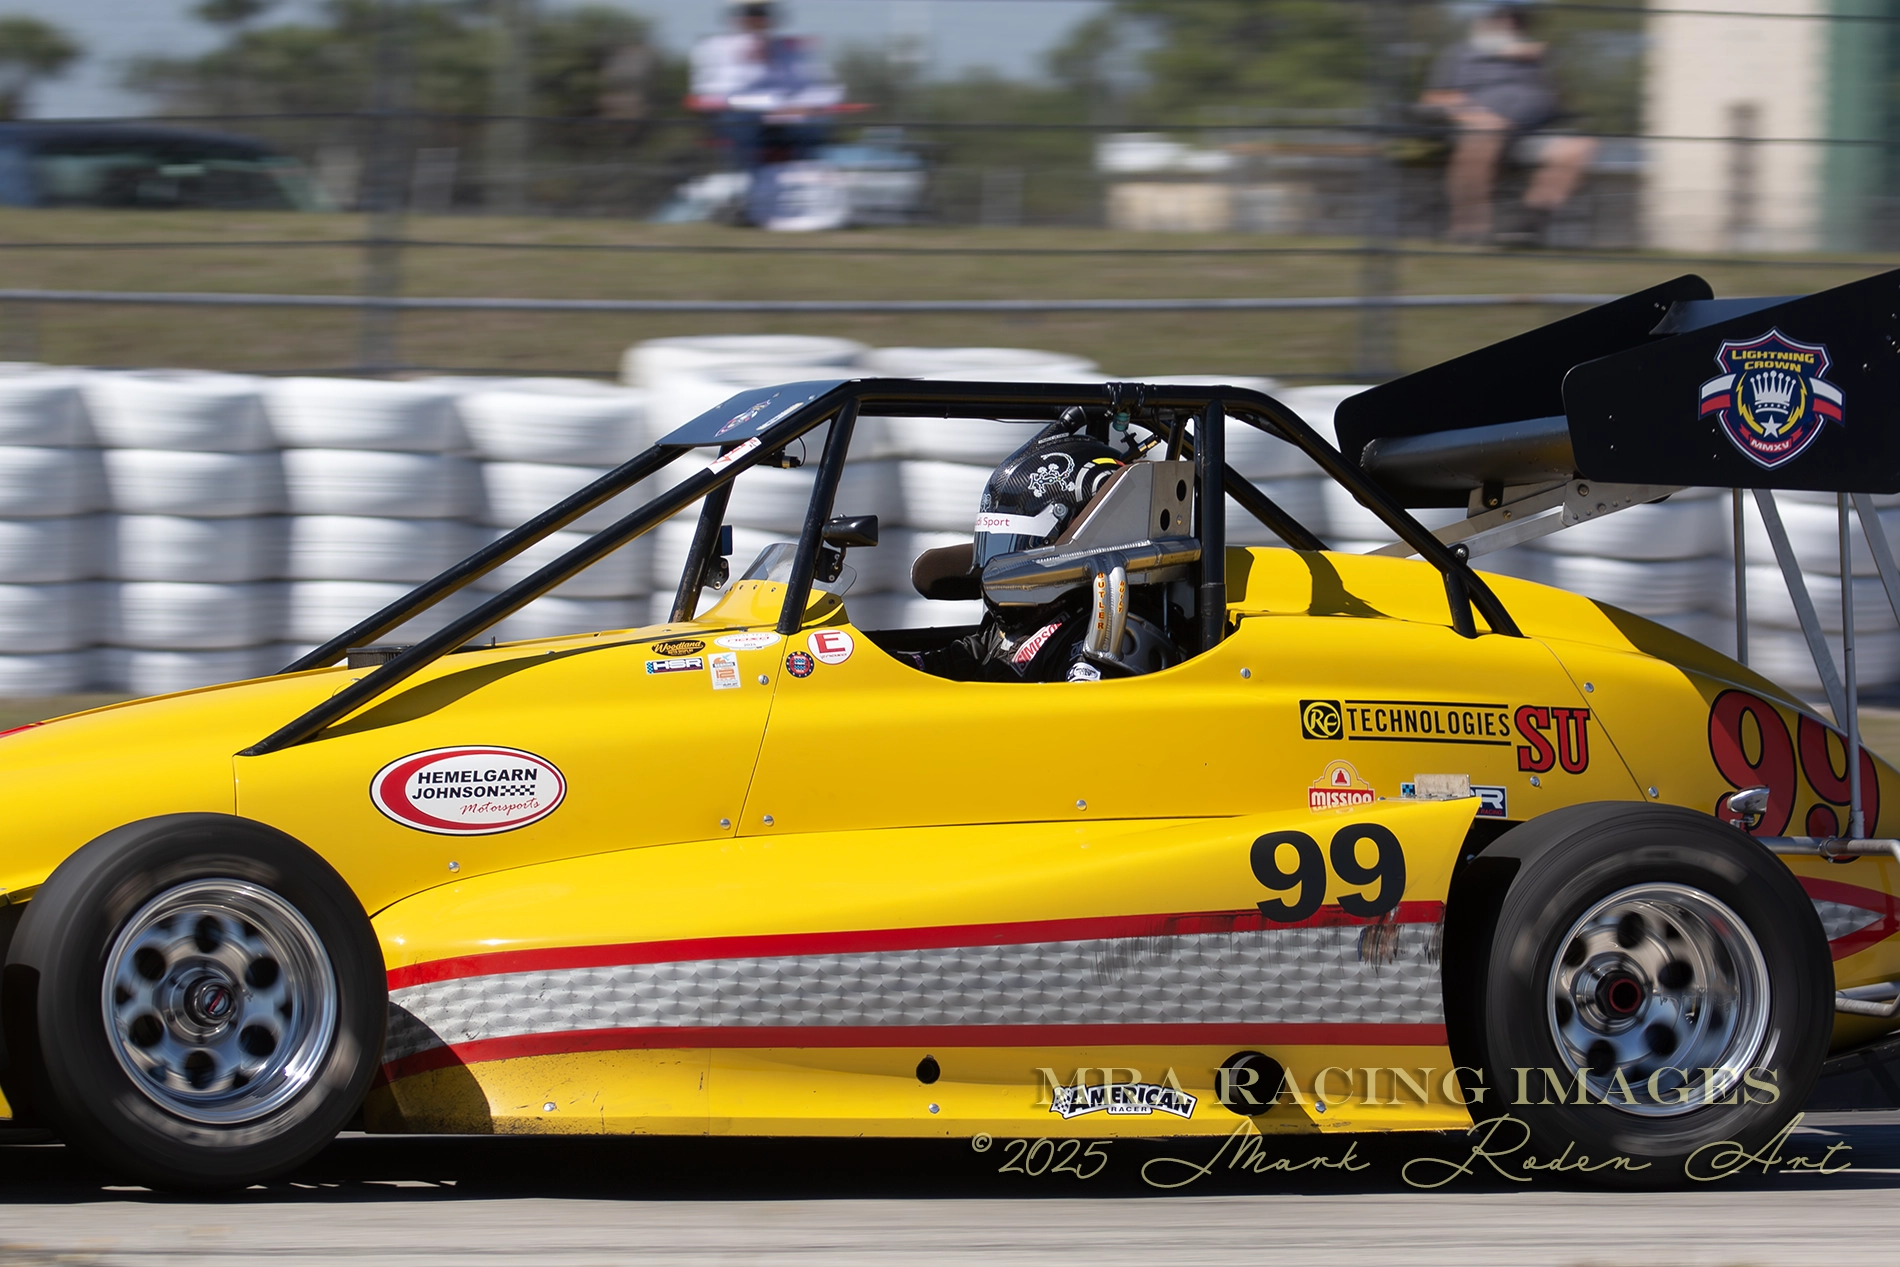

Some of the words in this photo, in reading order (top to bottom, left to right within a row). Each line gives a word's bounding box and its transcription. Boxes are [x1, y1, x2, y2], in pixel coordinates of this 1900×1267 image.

[1732, 350, 1815, 364] LIGHTNING
[1744, 360, 1802, 372] CROWN
[1750, 438, 1790, 452] MMXV
[983, 516, 1010, 528] Sport
[653, 641, 703, 653] Woodland
[814, 631, 846, 653] E
[653, 658, 702, 670] HSR
[1346, 708, 1511, 736] TECHNOLOGIES
[1514, 705, 1590, 774] SU
[417, 768, 538, 784] HEMELGARN
[1708, 689, 1880, 864] 99
[412, 786, 499, 800] JOHNSON
[460, 797, 541, 816] Motorsports
[1250, 823, 1406, 922] 99
[1068, 1086, 1193, 1114] AMERICAN
